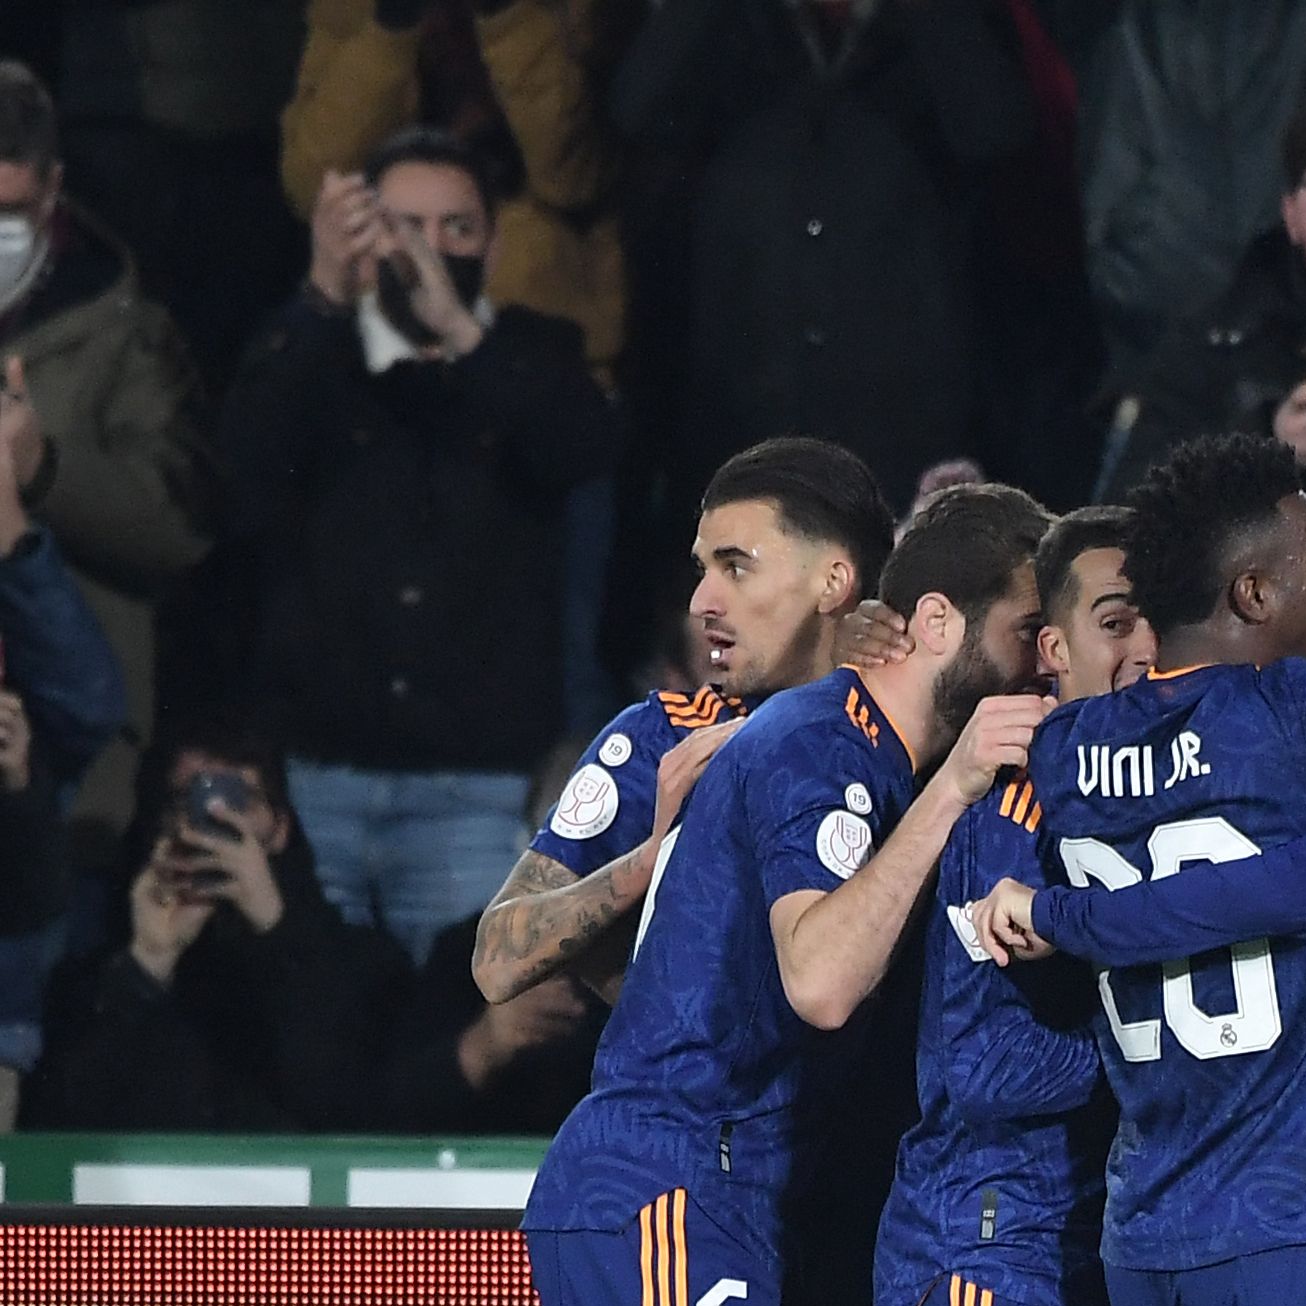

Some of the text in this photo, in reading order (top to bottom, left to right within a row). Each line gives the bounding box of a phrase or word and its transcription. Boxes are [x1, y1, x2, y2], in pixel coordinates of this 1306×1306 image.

[607, 742, 623, 757] 19
[1077, 730, 1211, 797] VINI JR.
